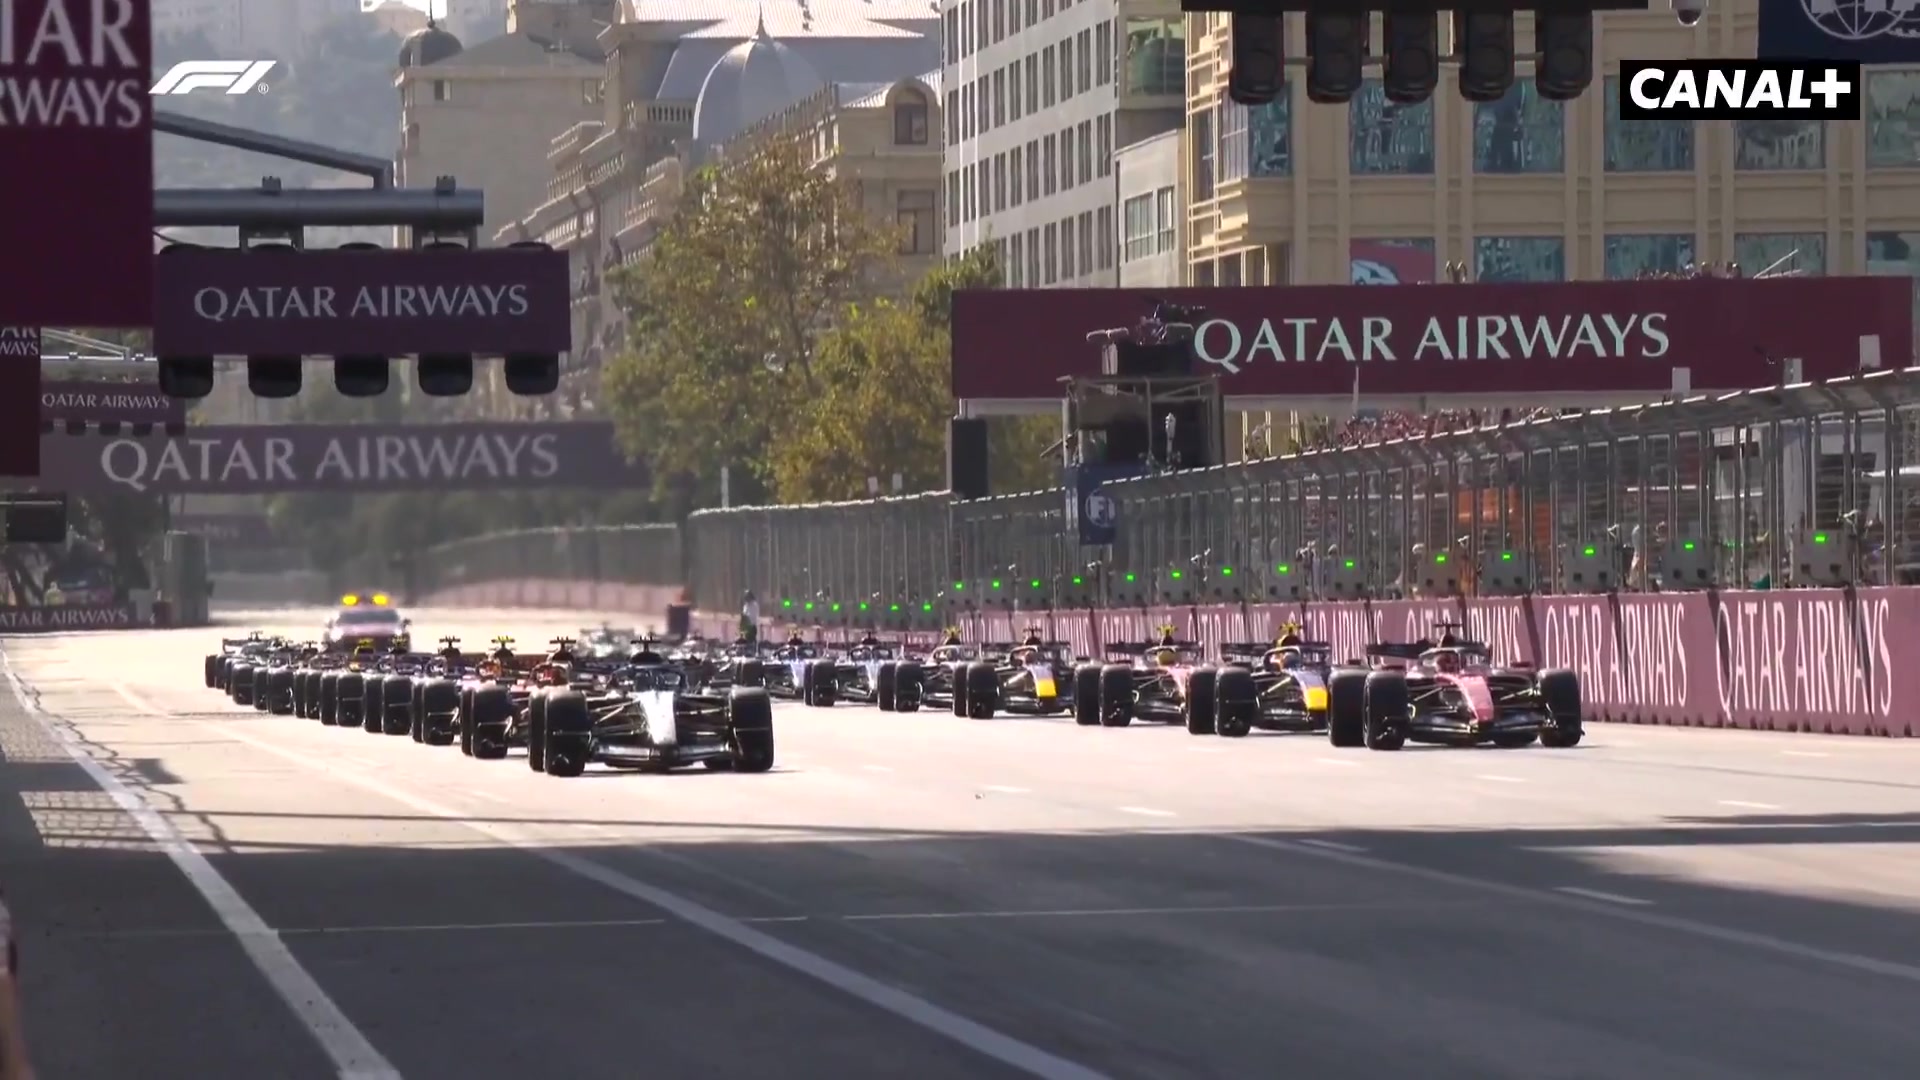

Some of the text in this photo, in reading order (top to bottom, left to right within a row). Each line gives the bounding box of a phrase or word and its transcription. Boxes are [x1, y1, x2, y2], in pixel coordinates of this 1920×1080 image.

[0, 77, 141, 128] WAYS
[194, 285, 528, 321] QATAR AIRWAYS
[1194, 313, 1670, 373] QATAR AIRWAYS
[42, 392, 170, 409] QATAR AIRWAYS
[101, 434, 559, 491] QATAR AIRWAYS
[50, 607, 129, 625] AIRWAYS
[1545, 602, 1687, 707] QATAR AIRWAYS
[1715, 598, 1892, 721] QATAR AIRWAYS
